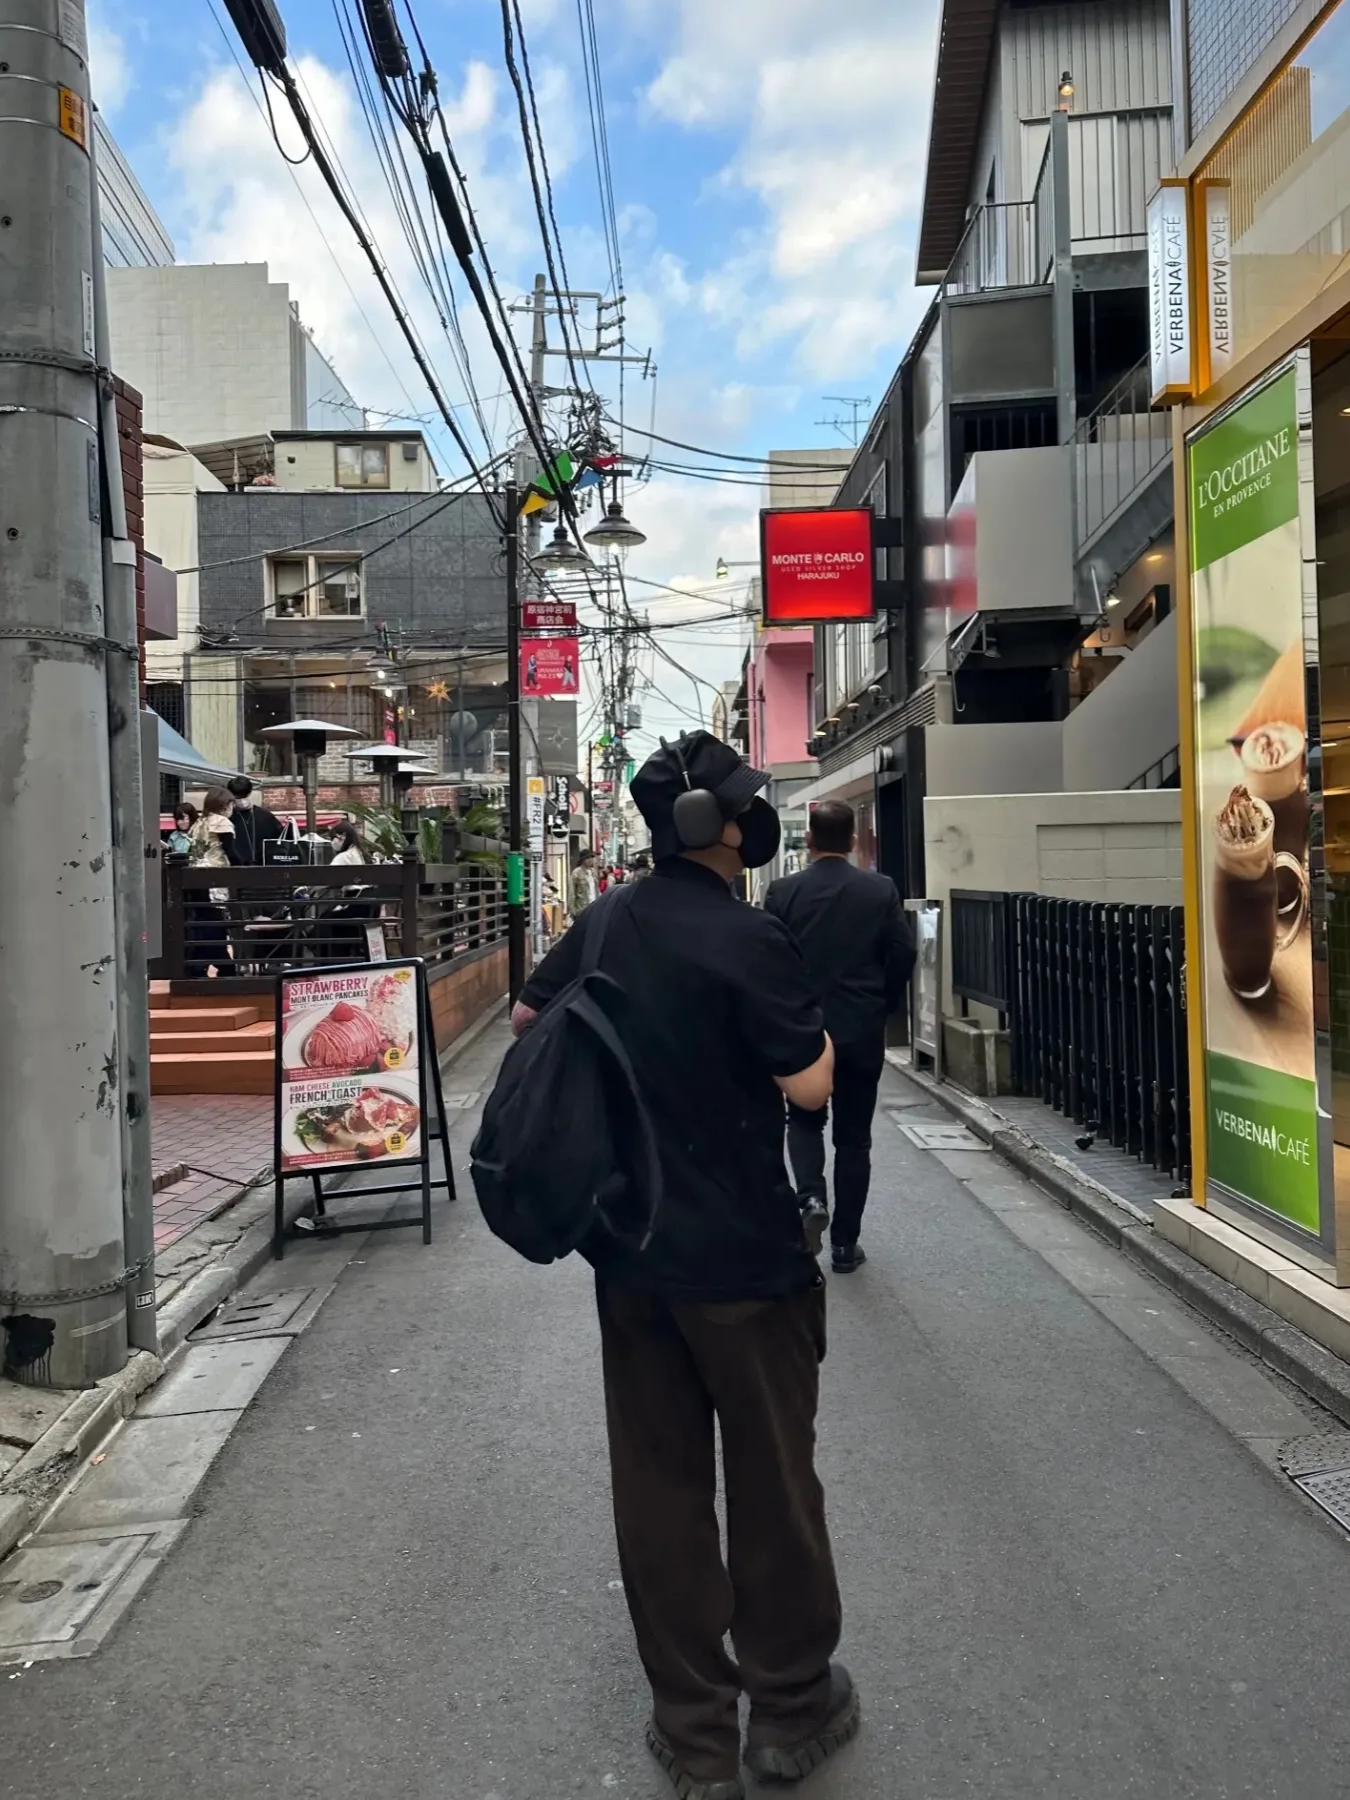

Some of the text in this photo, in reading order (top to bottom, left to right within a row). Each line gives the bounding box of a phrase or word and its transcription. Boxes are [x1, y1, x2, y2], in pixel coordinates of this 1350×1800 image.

[1162, 215, 1184, 355] VERBENA CAFÉ
[1198, 427, 1290, 509] L'OCCITANE
[1213, 472, 1272, 518] EN PROVENCE
[772, 552, 865, 565] MONTE CARLO
[797, 572, 840, 580] HARAJUKU
[556, 776, 569, 811] Scholl
[532, 796, 542, 824] #FR2
[290, 989, 369, 1004] MONT BLANC PANCAKES
[291, 976, 369, 996] STRAWBERRY
[289, 1079, 362, 1093] HAM CHEESE AVOCADO
[289, 1090, 328, 1104] FRENCH
[330, 1087, 362, 1100] TOAST
[1215, 1108, 1310, 1166] VERBENA CAFÉ
